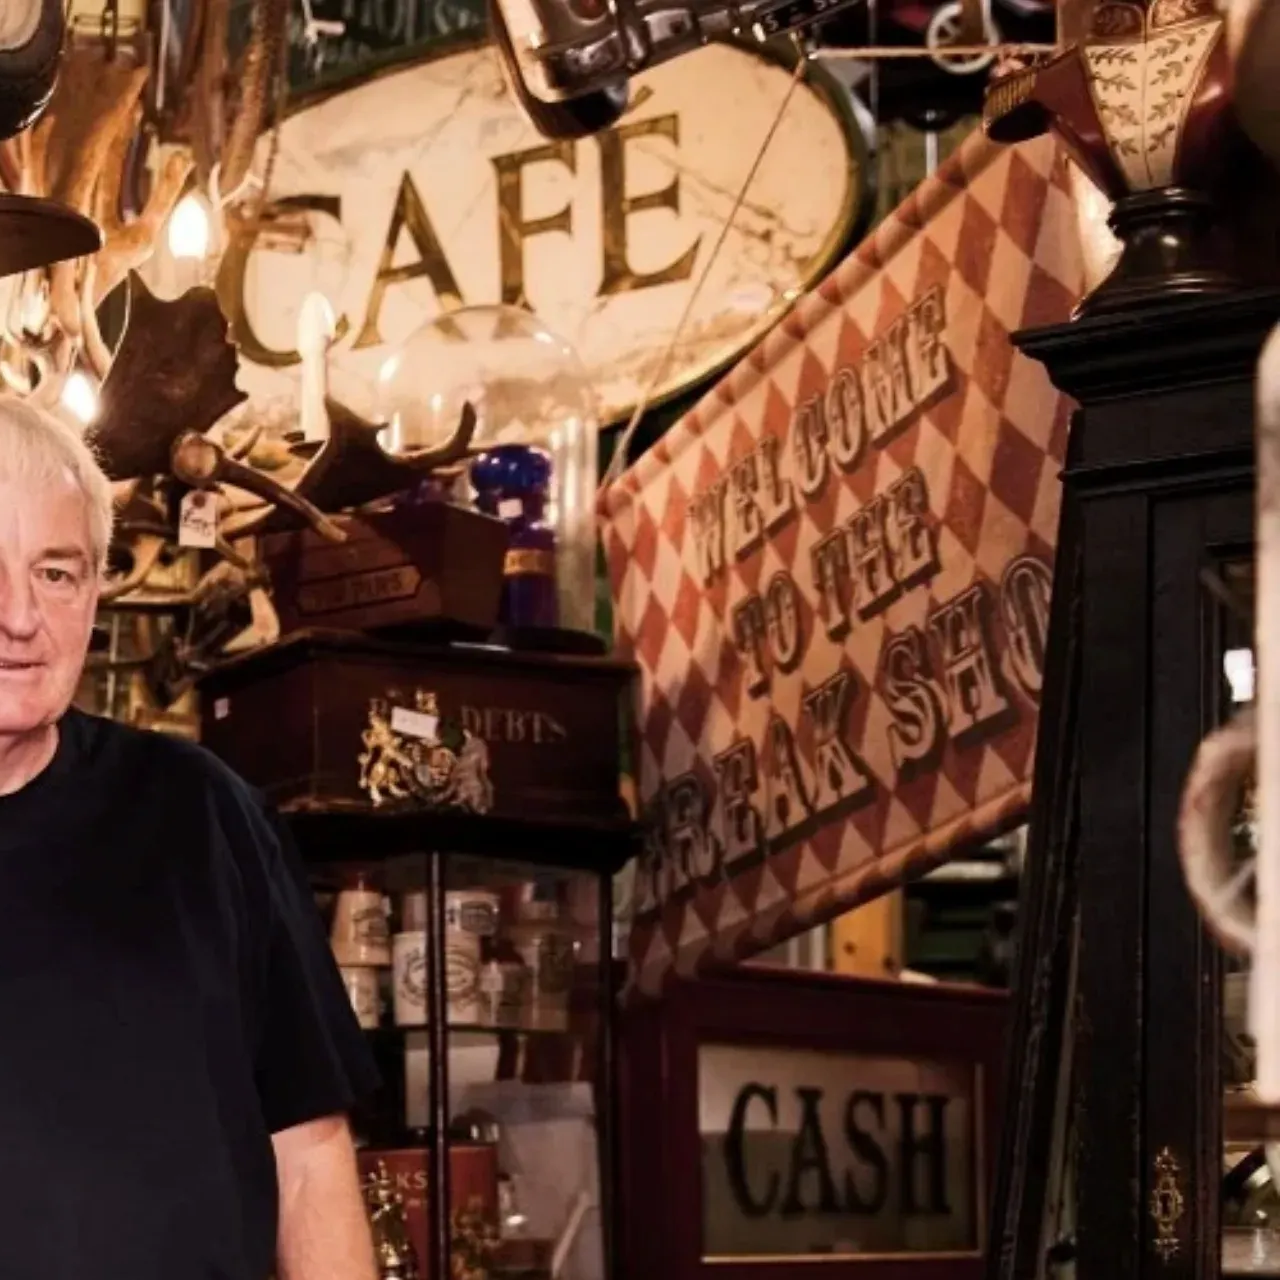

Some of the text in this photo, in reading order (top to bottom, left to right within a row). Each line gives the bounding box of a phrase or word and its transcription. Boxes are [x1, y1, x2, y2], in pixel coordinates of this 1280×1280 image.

[687, 284, 956, 588] WELCOME
[732, 465, 942, 698] TO THE
[723, 1081, 954, 1221] CASH
